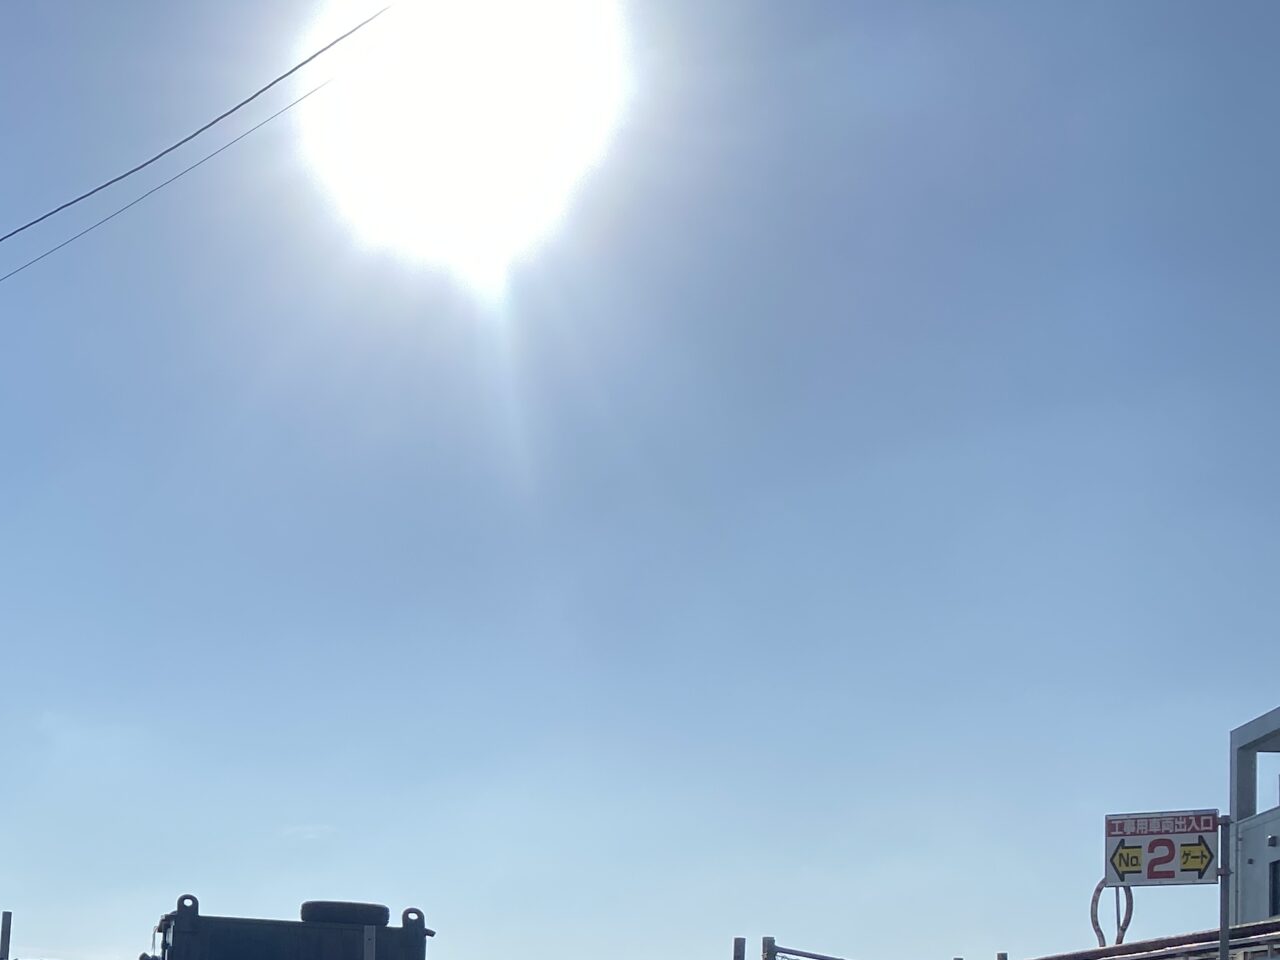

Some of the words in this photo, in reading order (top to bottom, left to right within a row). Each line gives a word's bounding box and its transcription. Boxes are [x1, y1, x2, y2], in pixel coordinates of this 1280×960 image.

[1111, 816, 1214, 835] 工事用車両出入口
[1118, 850, 1141, 867] No.
[1147, 838, 1176, 879] 2
[1181, 850, 1208, 865] ゲート
